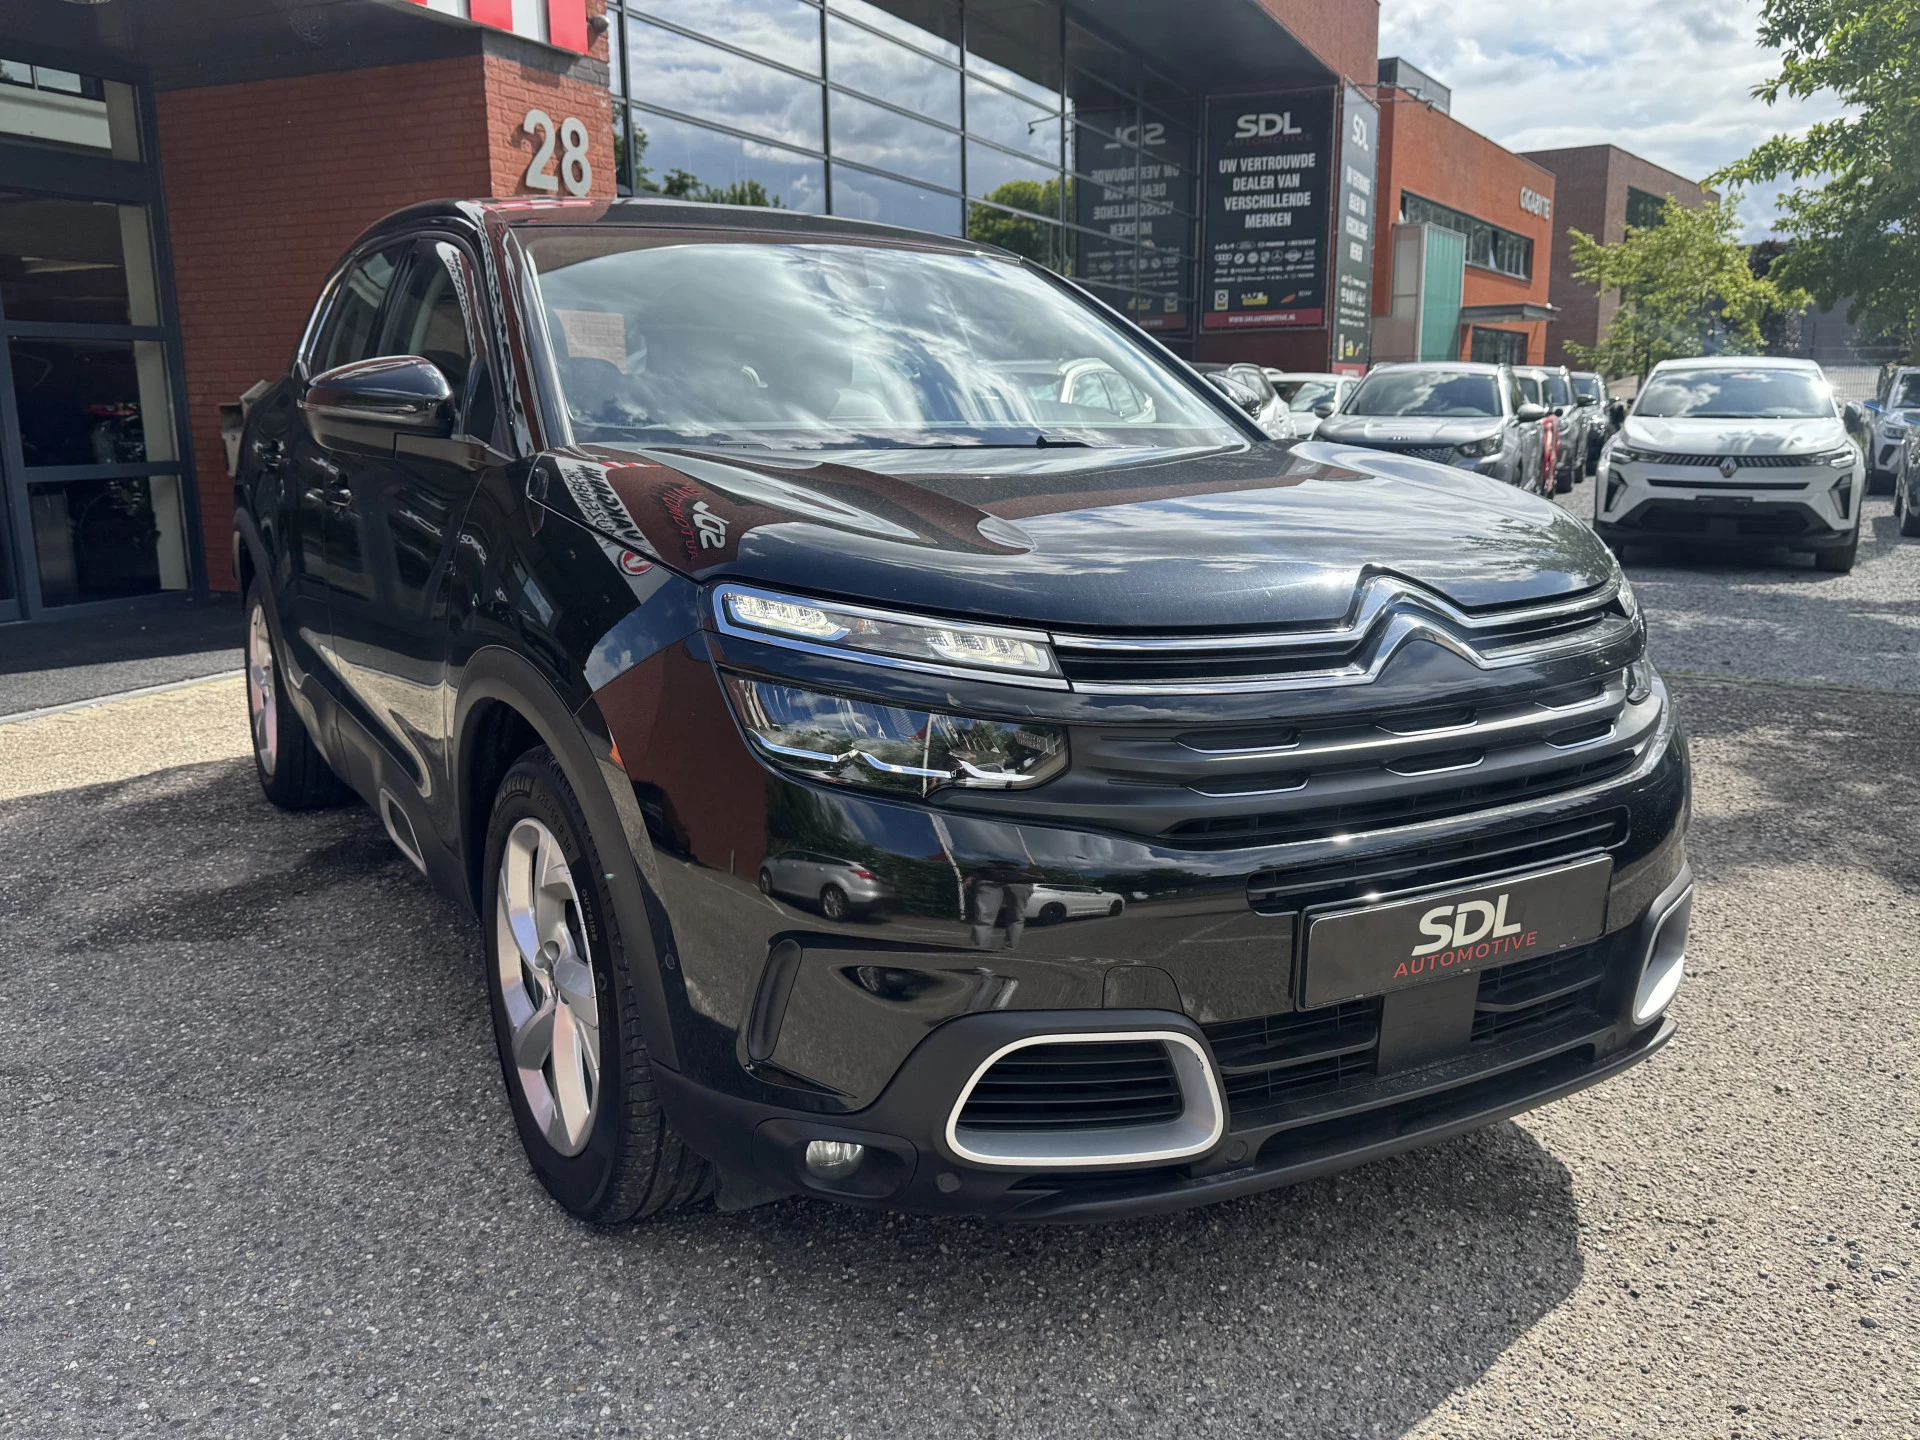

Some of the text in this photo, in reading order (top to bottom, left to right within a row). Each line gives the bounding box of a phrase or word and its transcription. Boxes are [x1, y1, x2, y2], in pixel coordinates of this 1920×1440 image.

[1235, 111, 1302, 138] SDL
[1351, 113, 1369, 152] SDL
[523, 109, 593, 198] 28
[1219, 153, 1316, 173] UW VERTROUWDE
[1233, 173, 1300, 191] DEALER VAN
[1224, 191, 1311, 211] VERSCHILLENDE
[1245, 212, 1292, 228] MERKEN
[581, 888, 598, 942] OUTSIDE
[1411, 893, 1521, 957] SDL
[1393, 931, 1538, 979] AUTOMOTIVE
